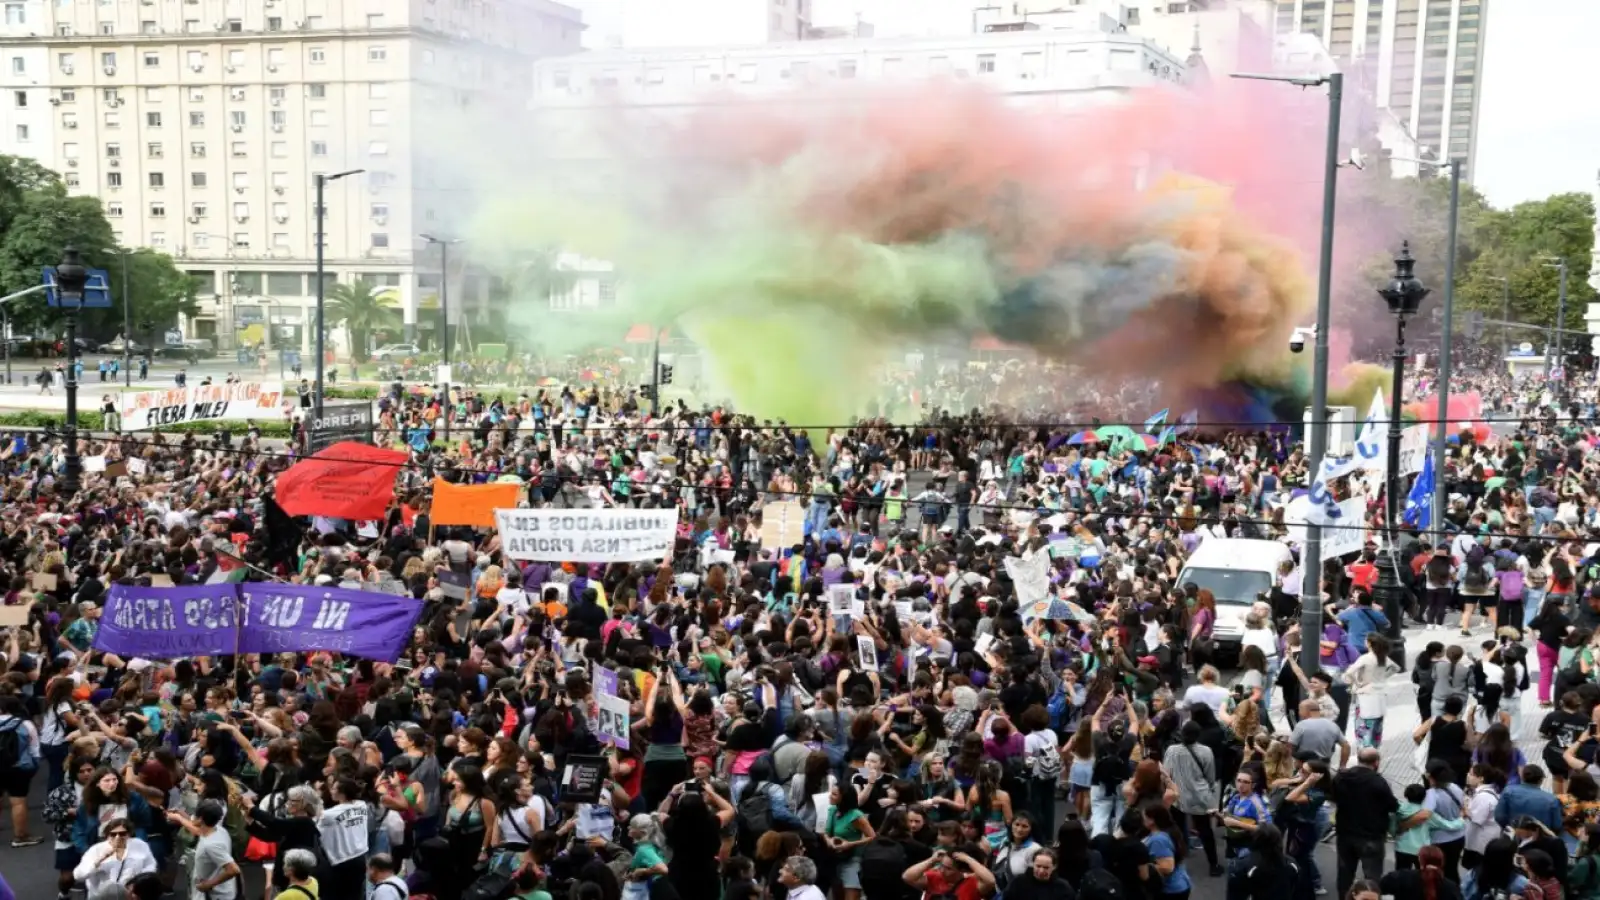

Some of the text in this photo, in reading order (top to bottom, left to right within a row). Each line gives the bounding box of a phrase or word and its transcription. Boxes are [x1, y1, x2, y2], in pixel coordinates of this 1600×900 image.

[147, 401, 229, 427] FUERA MILEI
[311, 412, 366, 430] ORREPI
